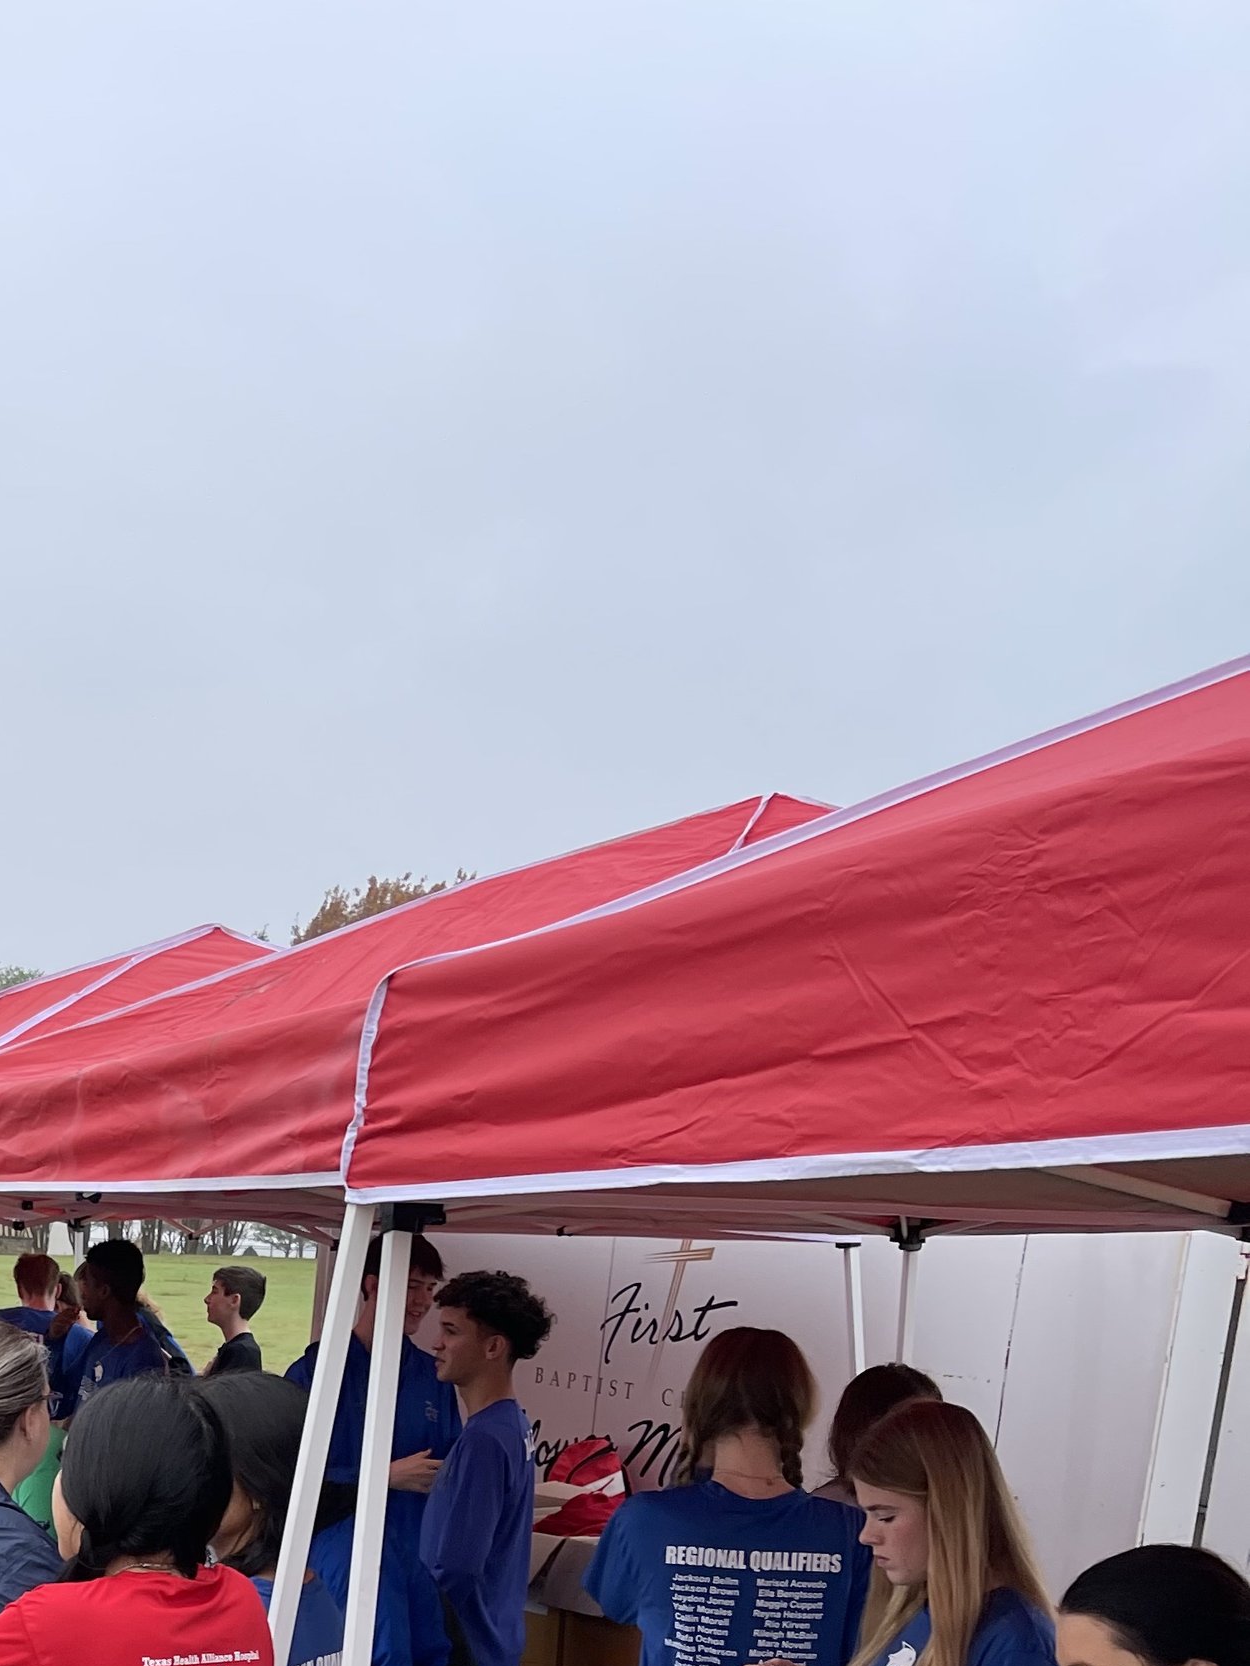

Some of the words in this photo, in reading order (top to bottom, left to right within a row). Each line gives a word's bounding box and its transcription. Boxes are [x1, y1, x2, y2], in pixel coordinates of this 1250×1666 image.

[600, 1282, 738, 1364] First
[535, 1367, 635, 1400] BAPTIST
[665, 1545, 746, 1570] REGIONAL
[750, 1551, 842, 1573] QUALIFIERS
[672, 1573, 711, 1583] Jackson
[670, 1583, 707, 1593] Jackson
[709, 1586, 740, 1596] Brown
[707, 1596, 735, 1606] Jones
[142, 1657, 172, 1666] Texas
[200, 1652, 233, 1664] Alliance
